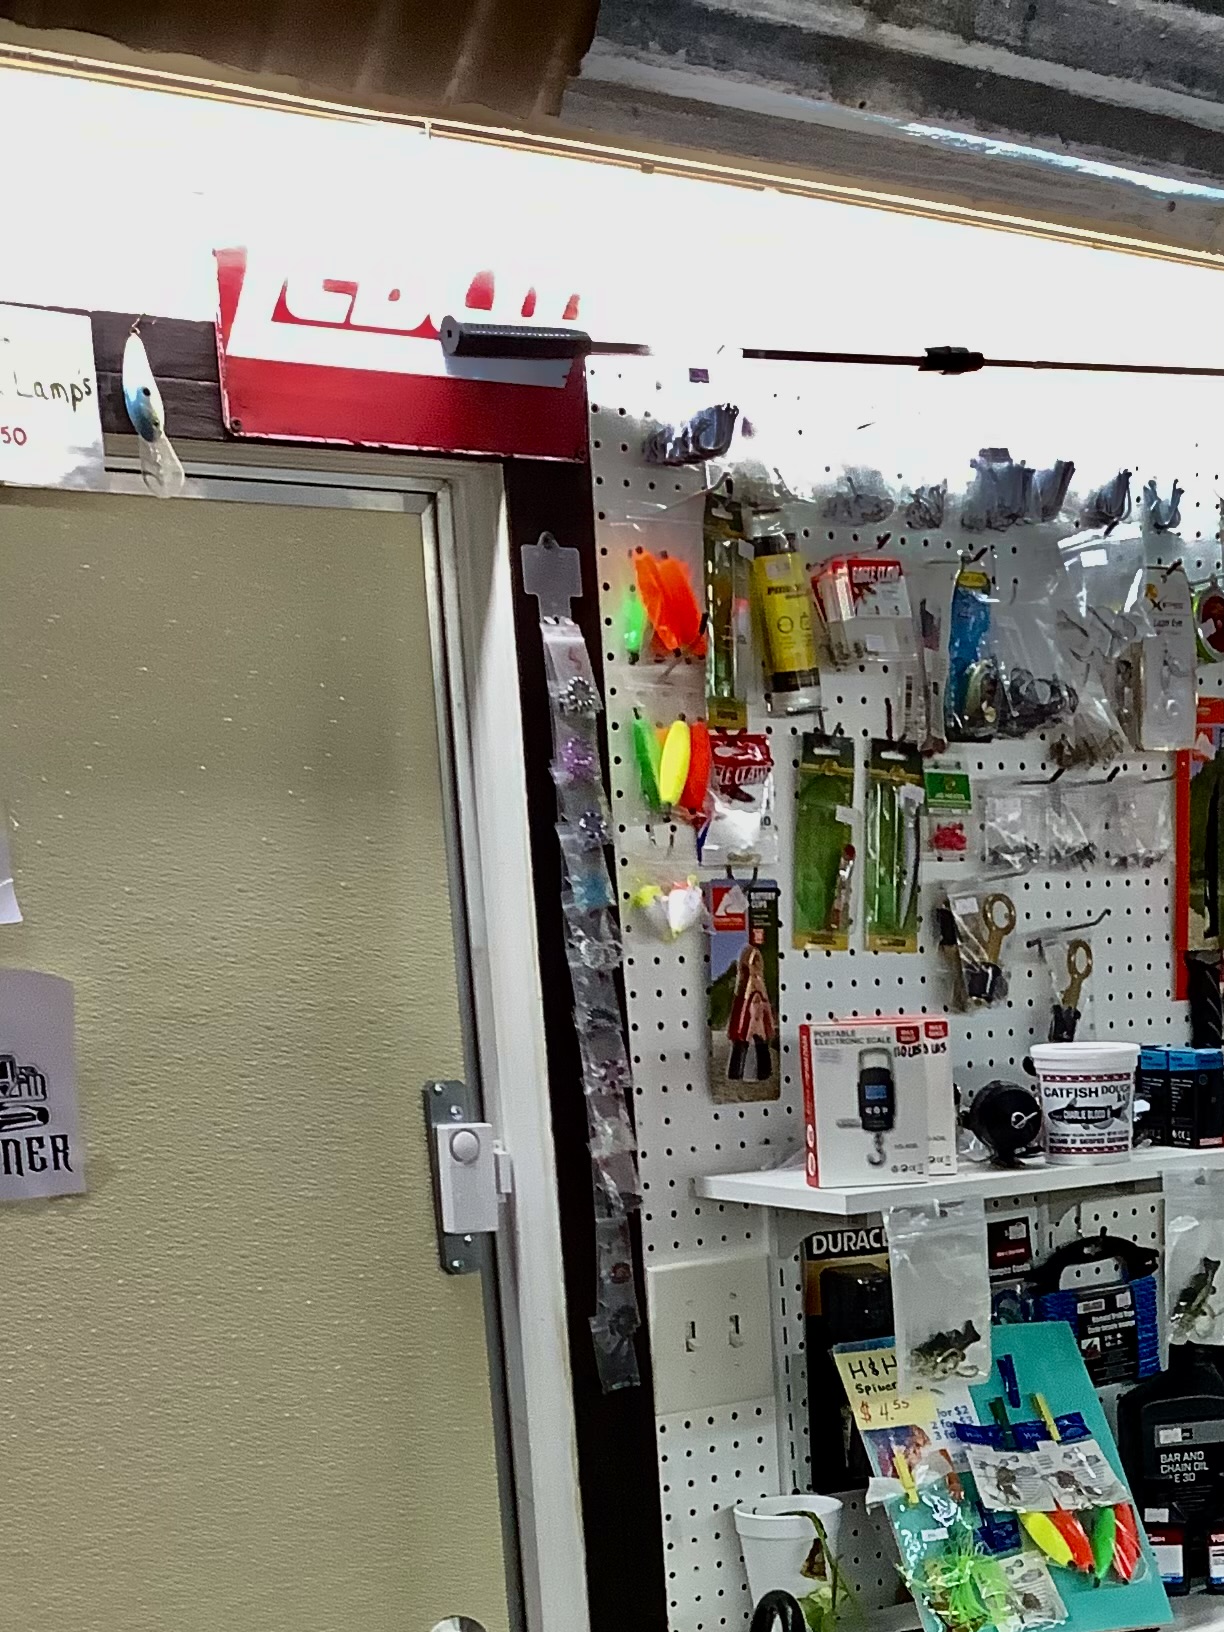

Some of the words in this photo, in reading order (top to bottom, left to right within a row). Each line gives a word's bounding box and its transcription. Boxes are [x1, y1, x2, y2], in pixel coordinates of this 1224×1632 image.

[813, 1030, 856, 1038] PORTABLE
[814, 1037, 864, 1046] ELECTRONIC
[866, 1036, 892, 1045] SCALE
[1044, 1086, 1099, 1098] CATFISH
[944, 1429, 957, 1440] fo
[1160, 1453, 1181, 1464] BAR
[1183, 1451, 1205, 1462] AND
[1160, 1463, 1191, 1474] CHAIN
[1193, 1461, 1209, 1472] OIL
